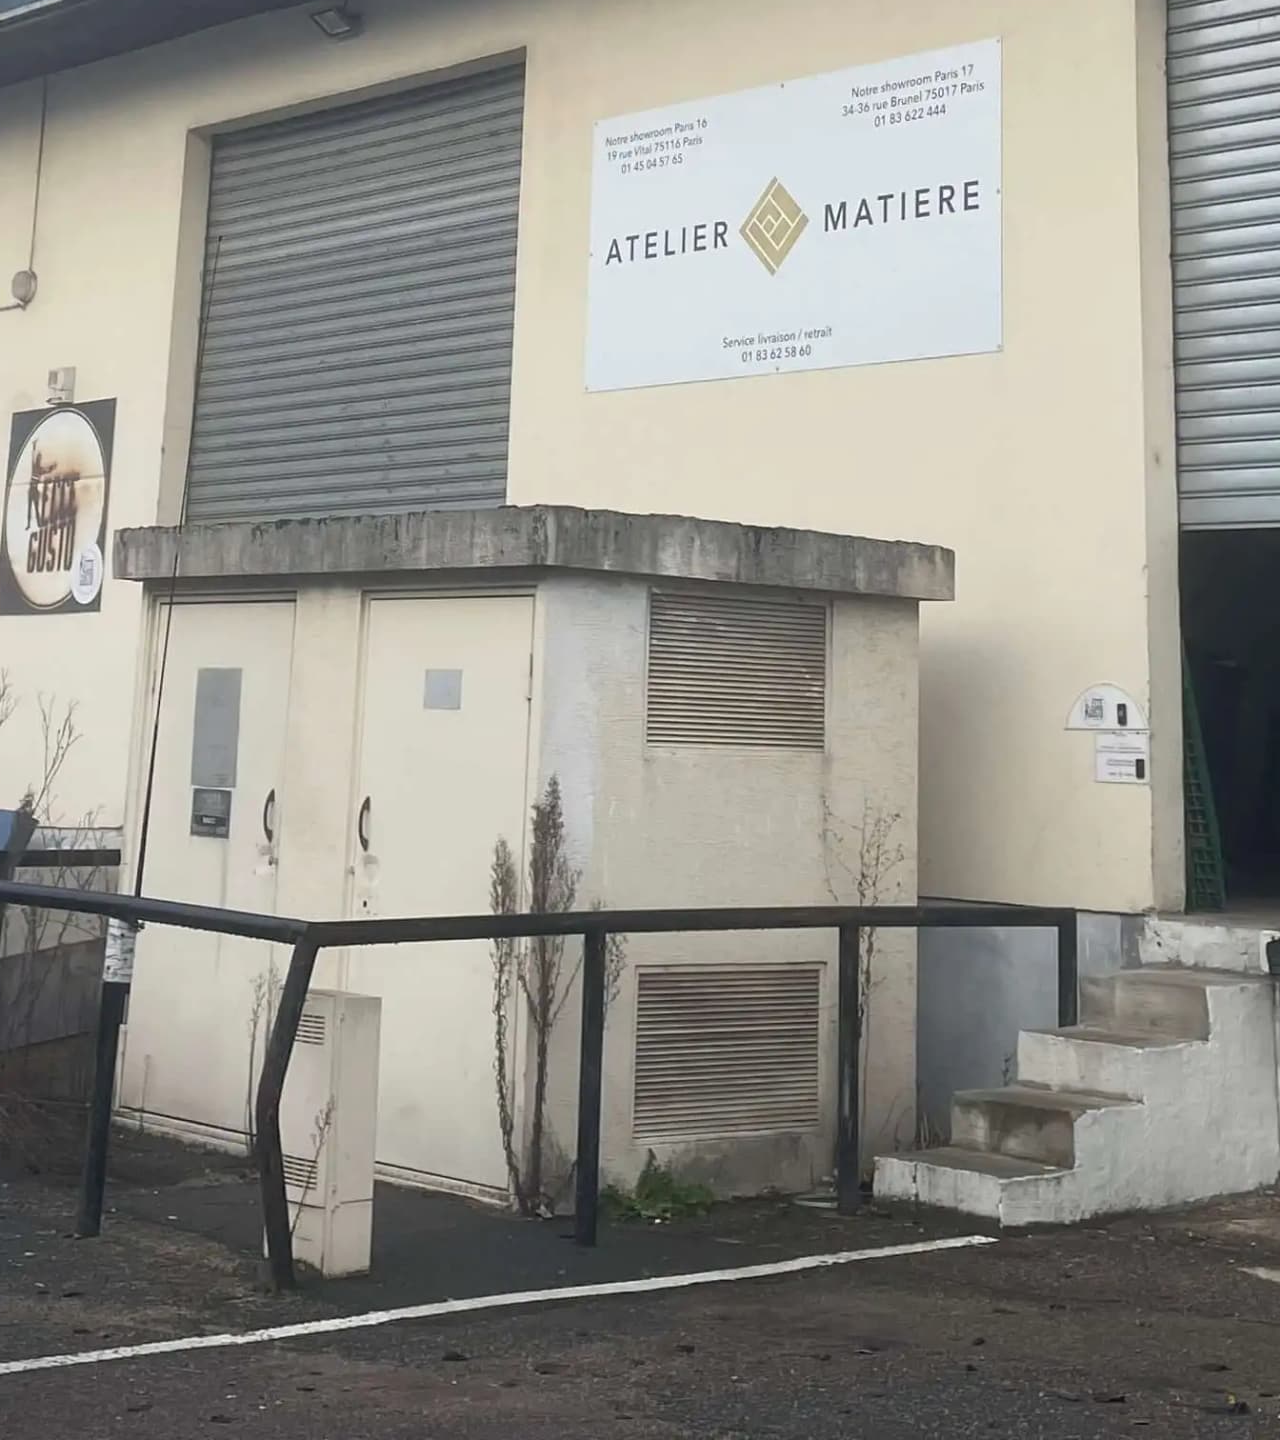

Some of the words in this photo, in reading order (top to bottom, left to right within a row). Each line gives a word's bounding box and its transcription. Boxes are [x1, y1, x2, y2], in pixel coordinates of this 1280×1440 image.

[851, 86, 878, 98] Notre
[881, 74, 932, 92] showroom
[934, 68, 958, 82] Paris
[961, 63, 974, 77] 17
[841, 102, 870, 117] 34-36
[872, 99, 888, 111] rue
[890, 91, 922, 107] Brunel
[925, 84, 958, 102] 75017
[960, 80, 985, 95] Paris
[874, 115, 886, 128] 01
[889, 111, 902, 125] 83
[904, 107, 924, 122] 622
[926, 103, 946, 116] 444
[605, 136, 628, 147] Notre
[630, 127, 672, 142] showroom
[674, 122, 694, 133] Paris
[696, 118, 708, 129] 16
[607, 150, 618, 161] 19
[619, 150, 632, 159] rue
[633, 144, 652, 156] Vital
[654, 139, 681, 152] 75116
[683, 135, 703, 147] Paris
[621, 163, 631, 174] 01
[633, 160, 645, 172] 45
[646, 159, 657, 170] 04
[659, 155, 670, 167] 57
[823, 179, 980, 233] MATIERE
[605, 220, 729, 266] ATELIER
[722, 335, 755, 349] Service
[757, 331, 796, 344] livraison
[804, 325, 832, 339] retrait
[741, 351, 752, 362] 01
[755, 349, 768, 361] 83
[770, 347, 782, 359] 62
[784, 346, 797, 357] 58
[799, 344, 811, 356] 60
